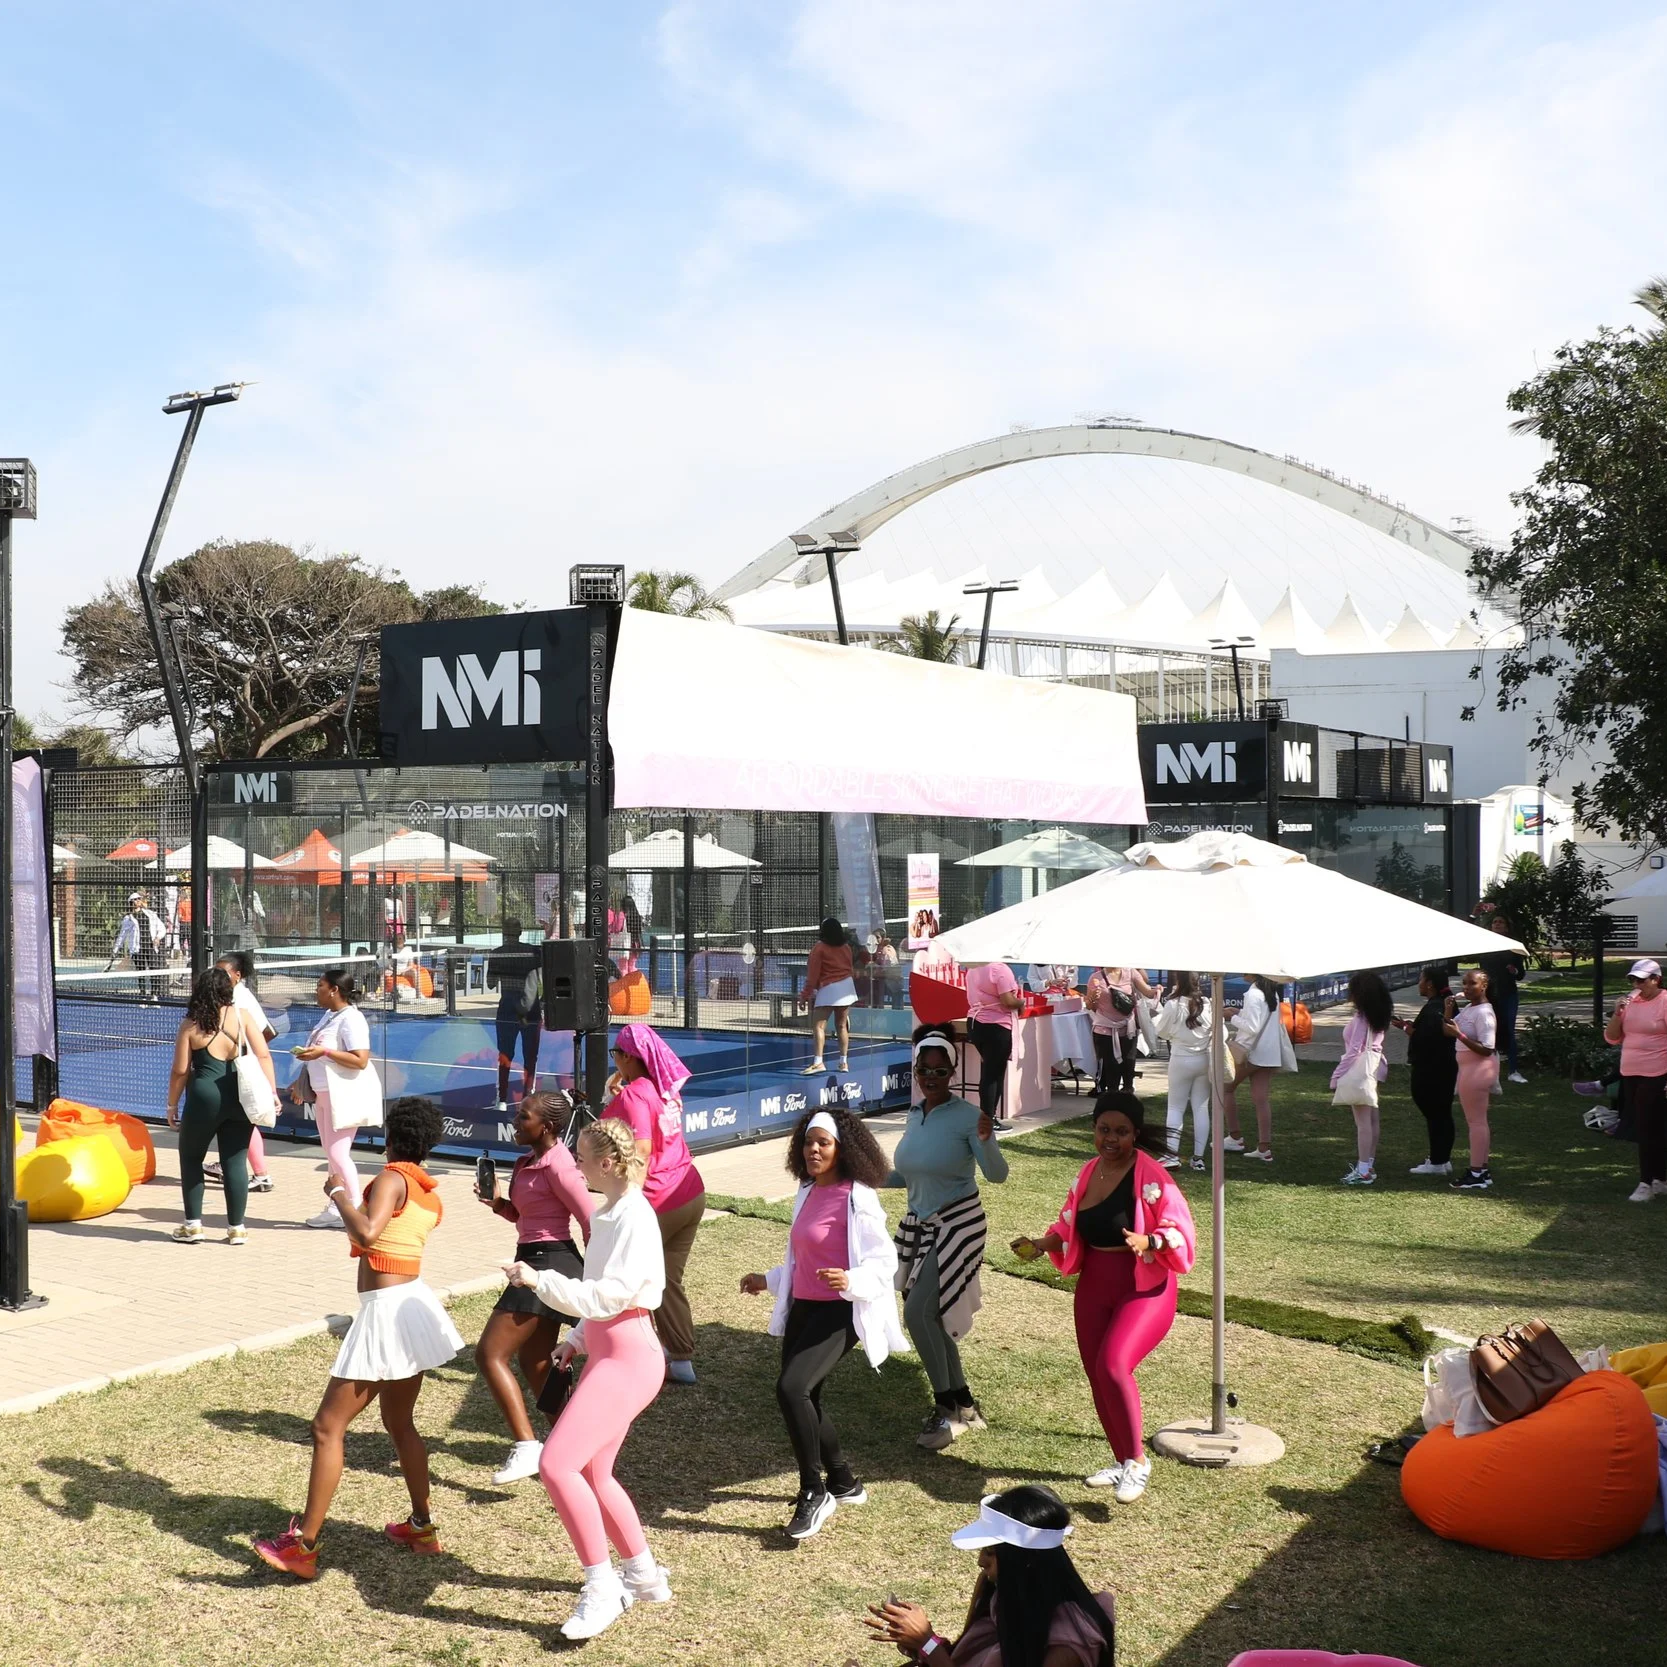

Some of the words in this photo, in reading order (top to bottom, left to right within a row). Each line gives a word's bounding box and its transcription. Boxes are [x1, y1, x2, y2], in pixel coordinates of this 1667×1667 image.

[422, 649, 541, 730] NMi
[1156, 741, 1236, 784] NMi
[234, 772, 277, 803] NMi
[732, 761, 884, 799] AFFORDABLE
[890, 773, 977, 804] SKINCARE
[983, 777, 1026, 806] THAT
[433, 803, 568, 819] PADELNATION
[1164, 824, 1253, 833] PADELNATION
[841, 1082, 862, 1101] Ford
[784, 1093, 806, 1112] Ford
[442, 1116, 473, 1138] Ford
[711, 1107, 737, 1128] Ford
